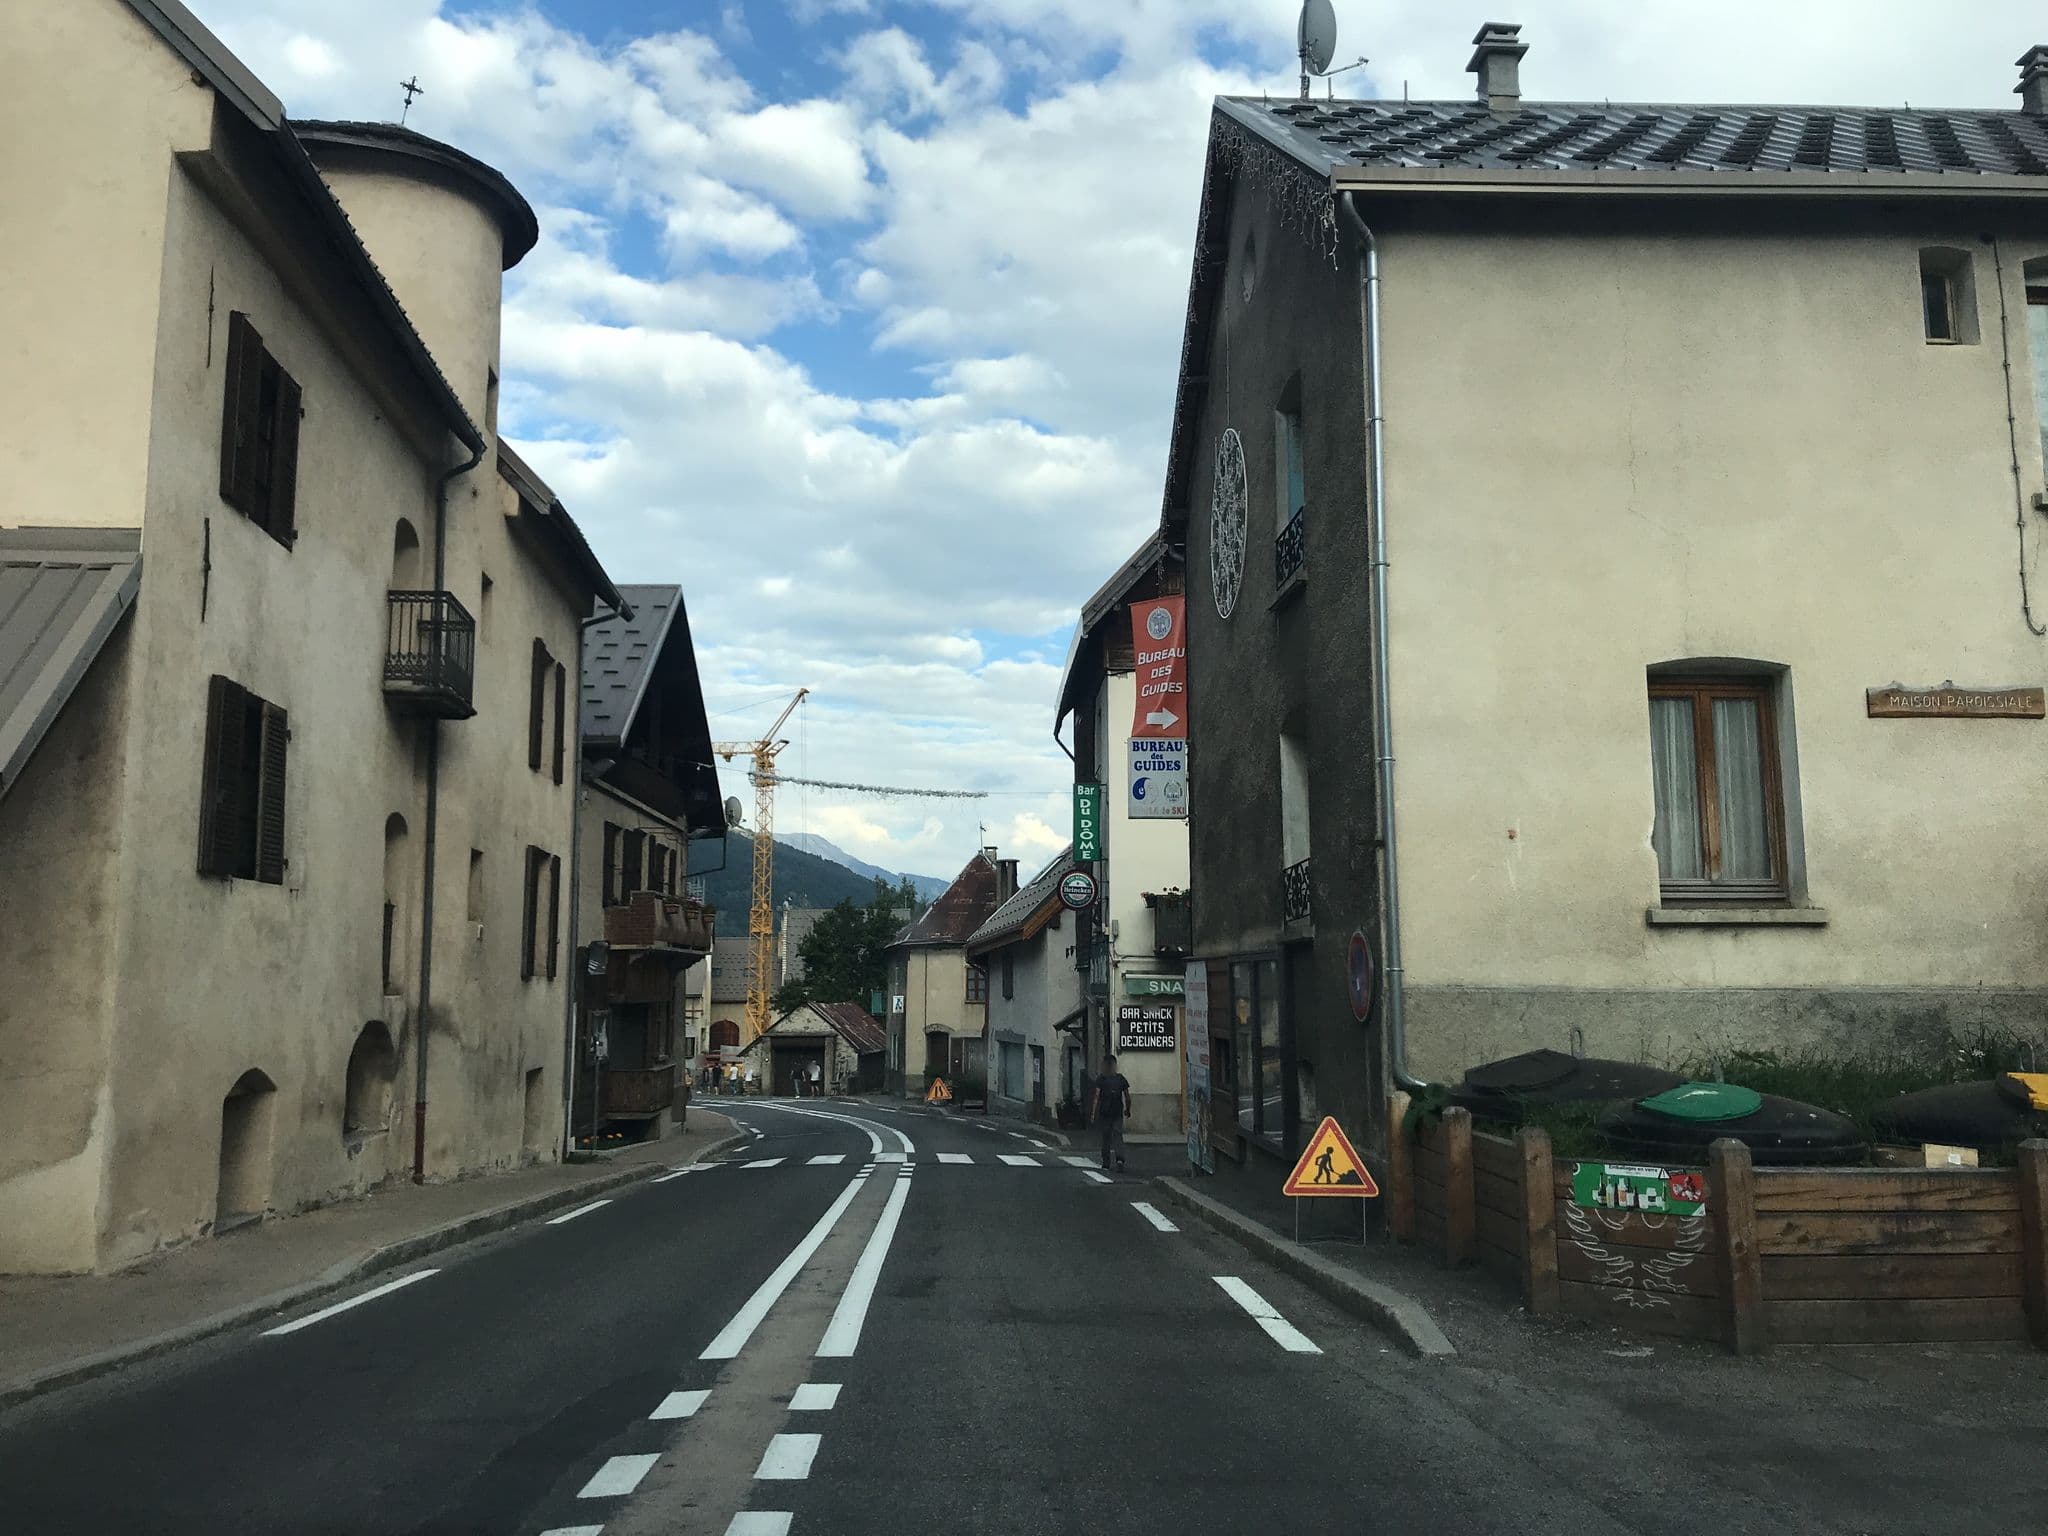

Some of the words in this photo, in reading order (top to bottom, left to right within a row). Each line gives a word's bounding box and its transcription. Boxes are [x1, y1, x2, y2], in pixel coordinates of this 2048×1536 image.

[1137, 647, 1185, 665] BUREAU
[1151, 665, 1172, 679] DES
[1141, 682, 1183, 697] GUIDES
[1890, 696, 1940, 708] MAISON
[1948, 696, 2032, 709] PAROISSIALE
[1132, 741, 1183, 752] BUREAU
[1134, 760, 1181, 771] GUIDES
[1077, 785, 1095, 795] Bar
[1121, 1008, 1140, 1019] BAR
[1143, 1008, 1172, 1019] SNACK
[1130, 1021, 1164, 1033] PETITS
[1121, 1036, 1174, 1047] DEJEUNERS
